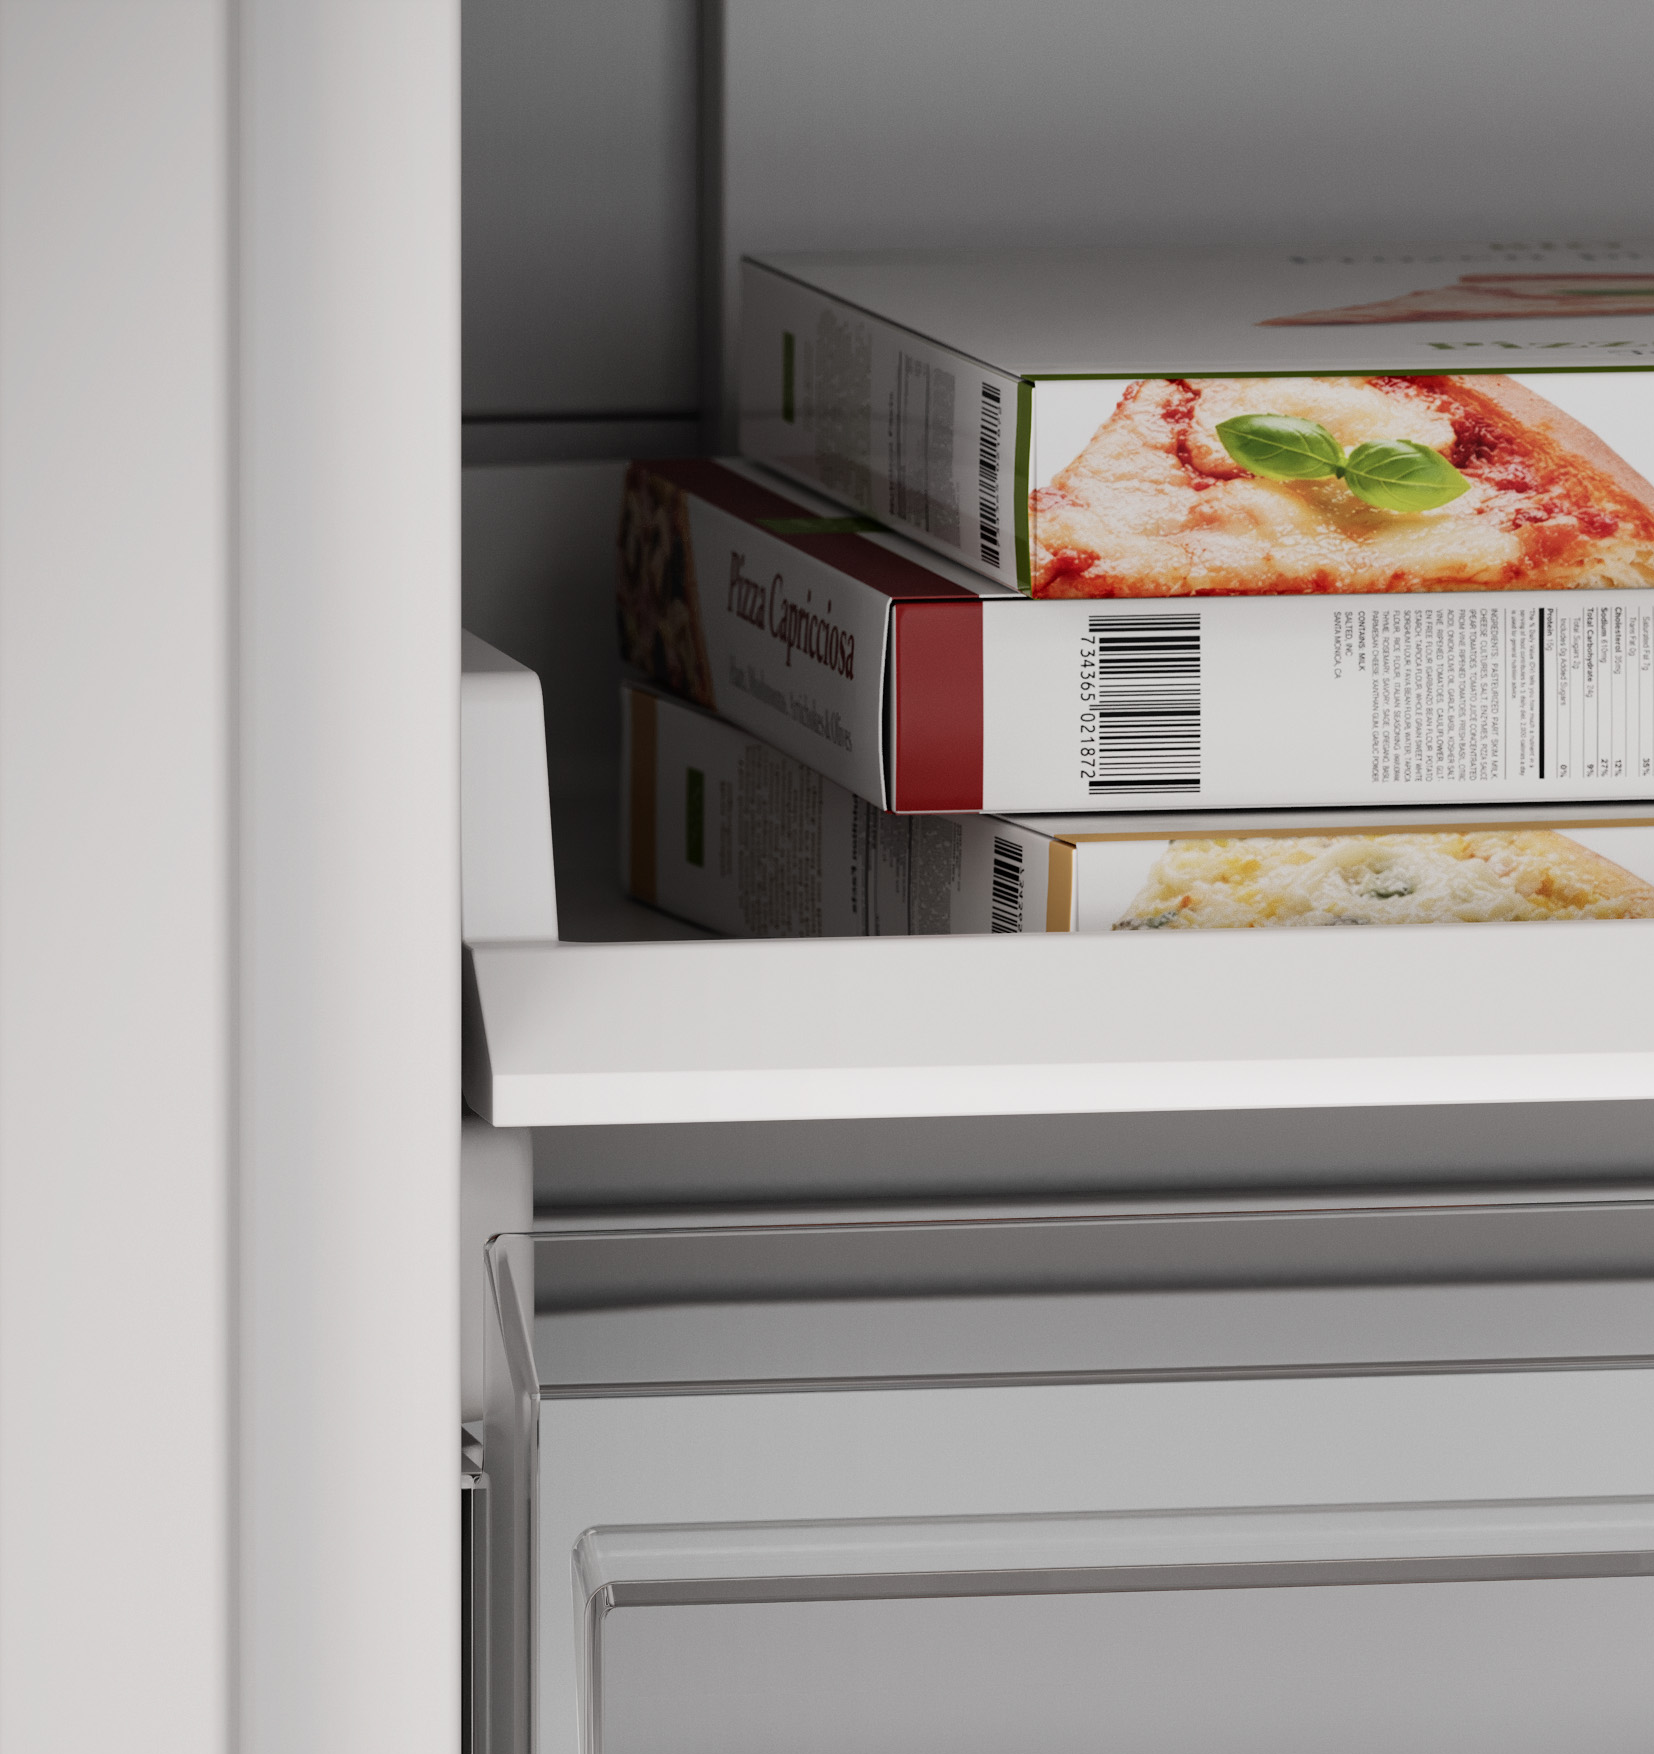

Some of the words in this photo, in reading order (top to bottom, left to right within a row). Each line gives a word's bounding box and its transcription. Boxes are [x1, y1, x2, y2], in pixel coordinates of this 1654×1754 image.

[727, 551, 766, 631] Pizza
[768, 573, 856, 681] Capricciosa
[1573, 617, 1581, 633] Total
[1600, 607, 1608, 637] Sodium
[1629, 617, 1637, 634] Trans
[1614, 607, 1622, 653] Cholesterol
[1629, 636, 1637, 646] Fat
[1642, 616, 1651, 648] Saturated
[1572, 635, 1581, 659] Sugars
[1586, 629, 1594, 682] Carbohydrate
[1642, 649, 1650, 660] Fat
[1080, 636, 1096, 701] 734365
[1560, 658, 1568, 680] Added
[1559, 682, 1568, 706] Sugars
[1080, 713, 1096, 779] 021872
[1560, 764, 1568, 778] 0%
[1586, 764, 1594, 777] 9%
[1642, 758, 1650, 776] 35%
